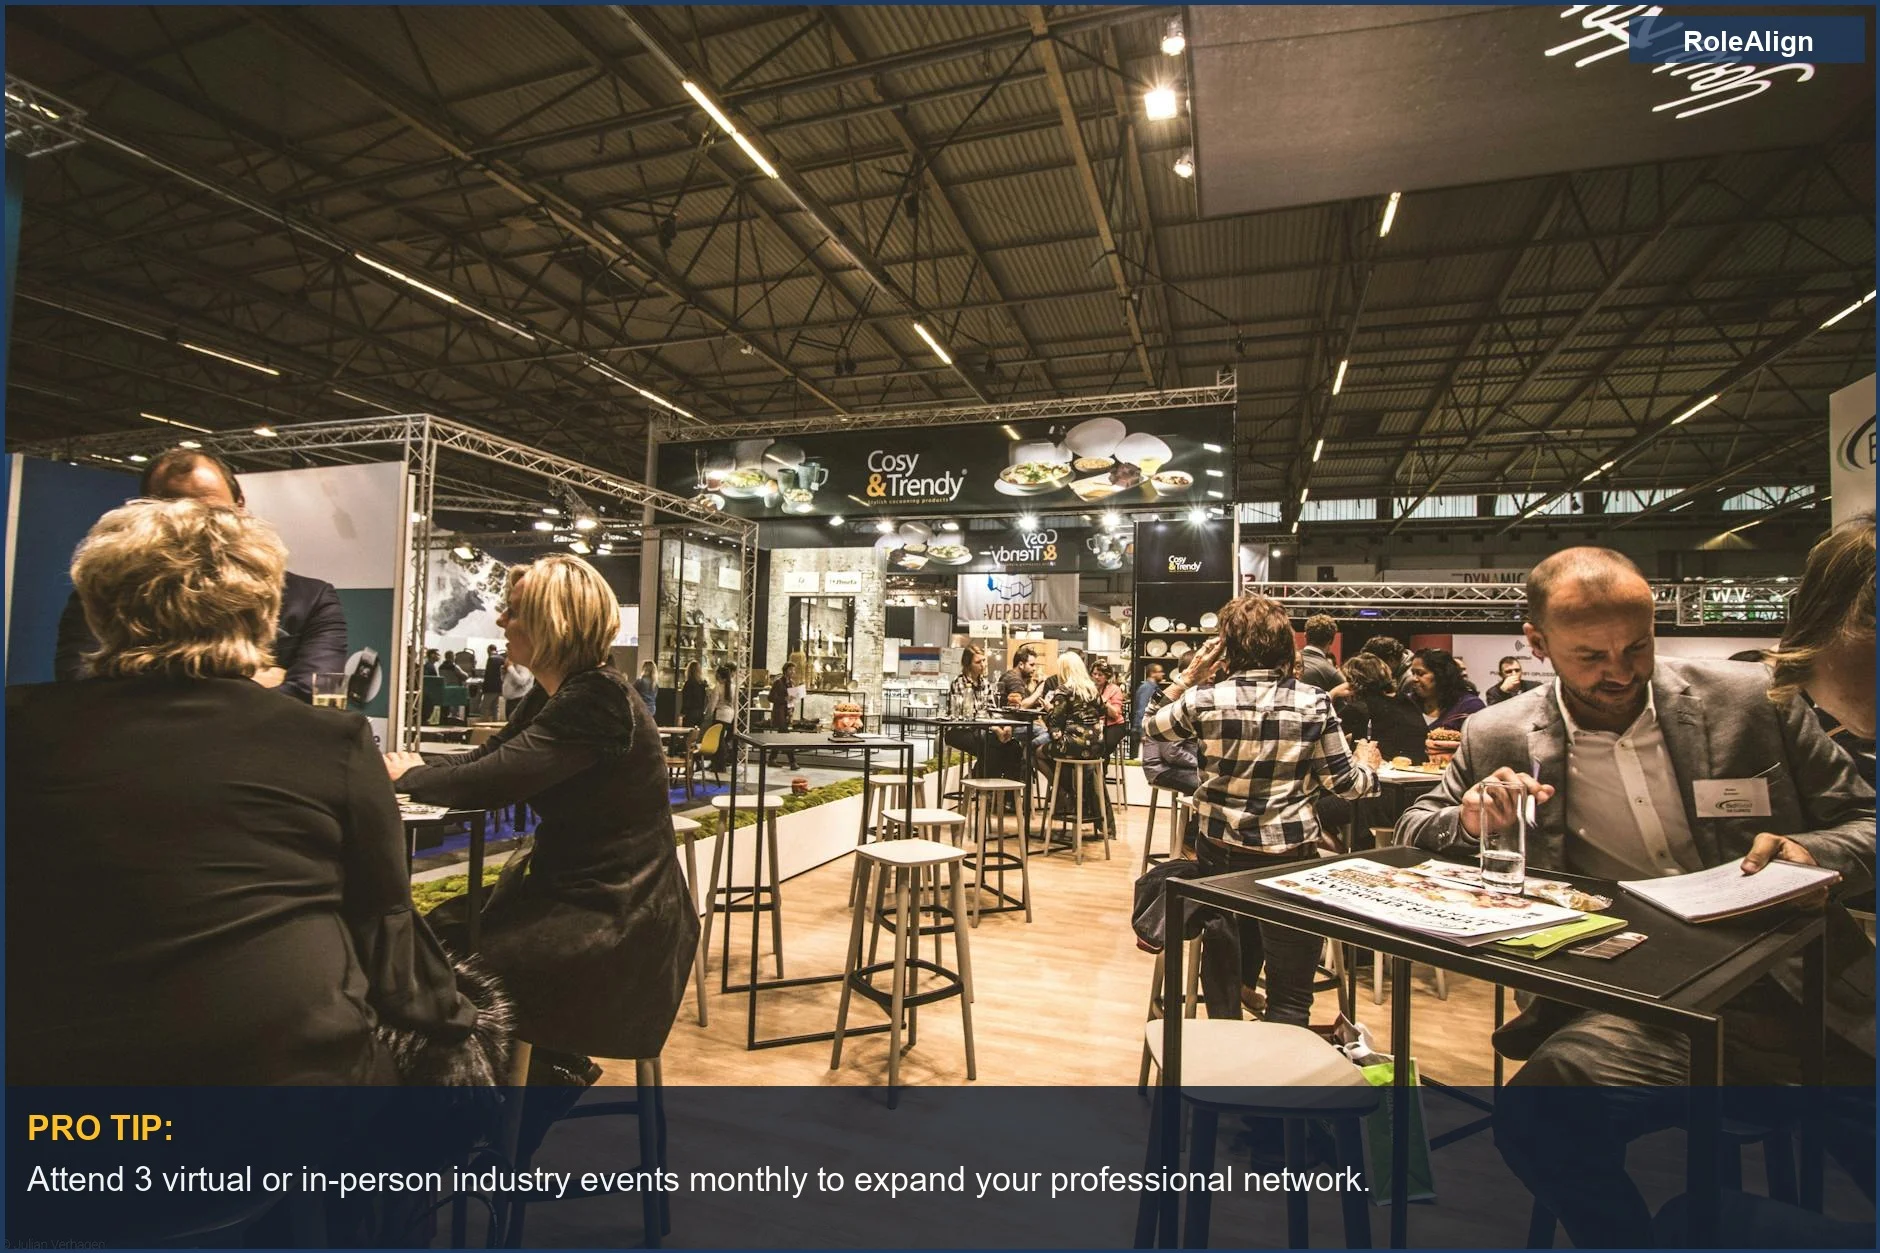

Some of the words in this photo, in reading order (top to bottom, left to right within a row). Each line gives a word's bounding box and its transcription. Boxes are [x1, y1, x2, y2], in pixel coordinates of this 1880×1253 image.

[867, 449, 920, 477] Cosy
[921, 497, 949, 505] products
[1168, 555, 1187, 564] Cosy
